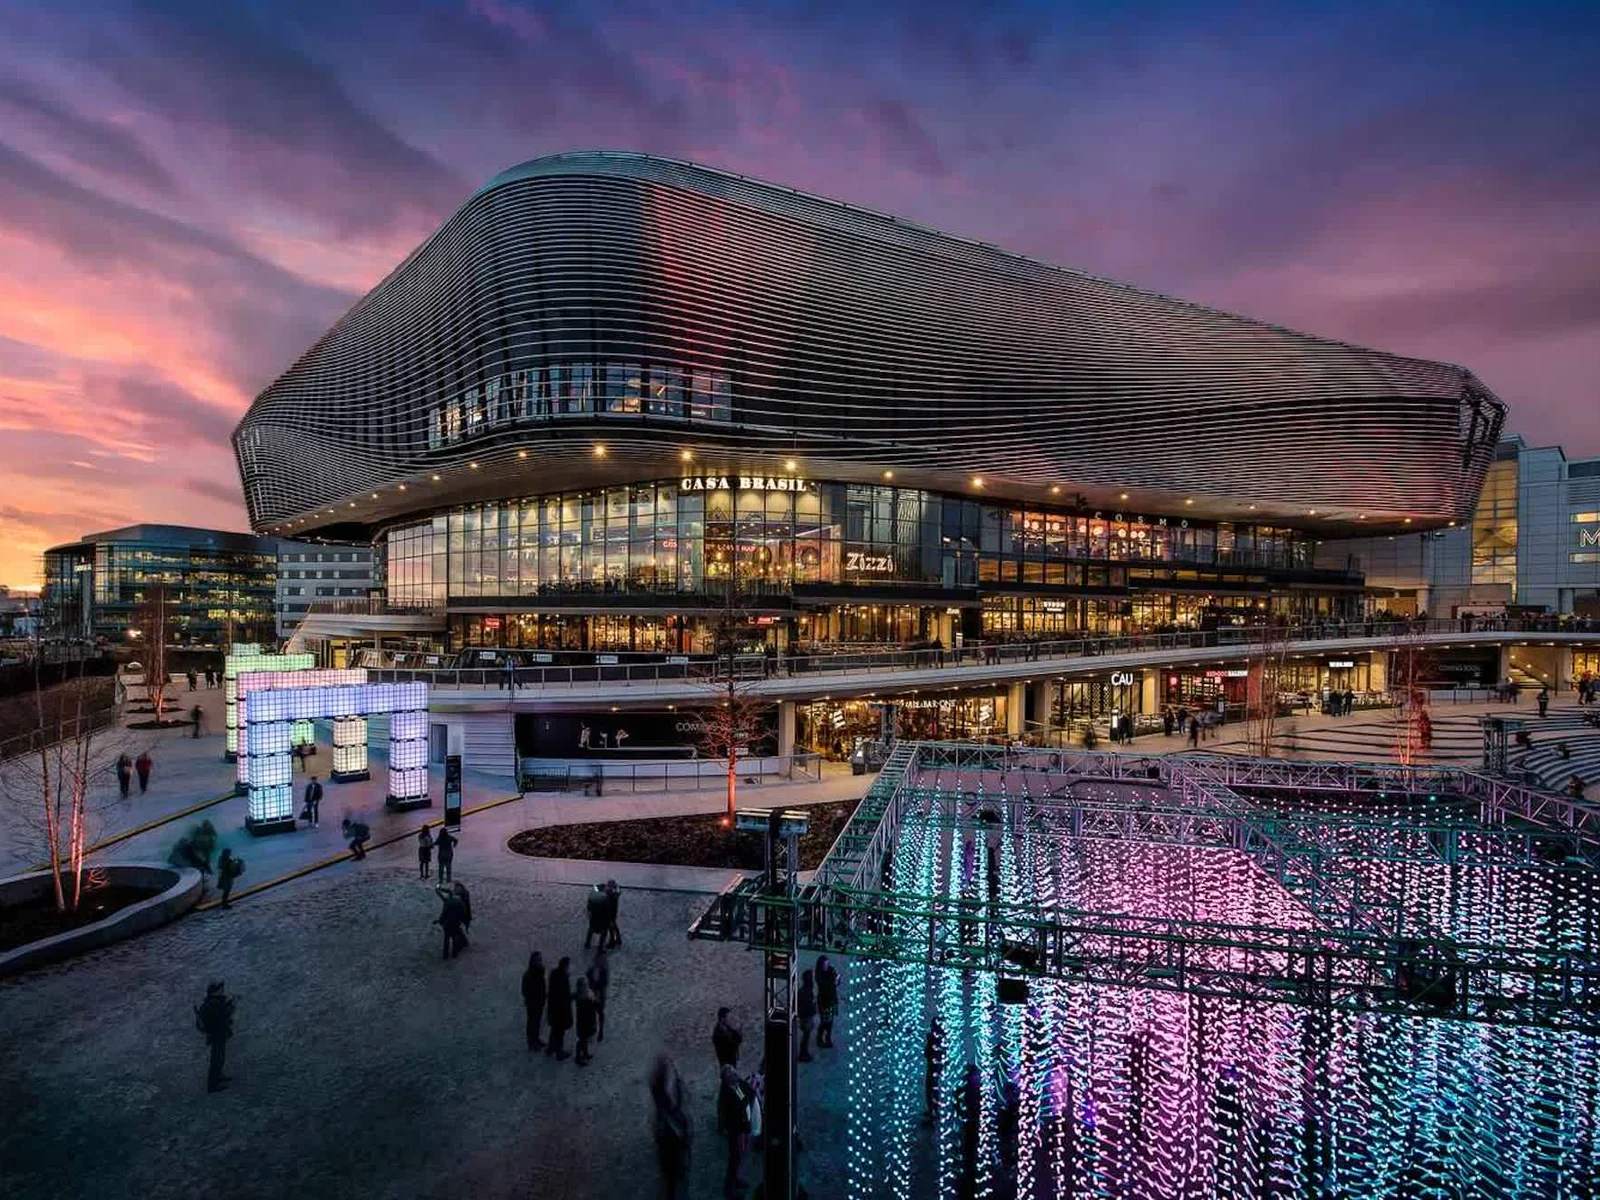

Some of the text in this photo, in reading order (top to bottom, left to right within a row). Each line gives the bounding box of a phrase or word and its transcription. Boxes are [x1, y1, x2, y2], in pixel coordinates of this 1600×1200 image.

[681, 477, 807, 491] CASA BRASIL
[1094, 511, 1189, 529] COSMO
[845, 552, 894, 573] Zizzi
[1110, 672, 1134, 686] CAU
